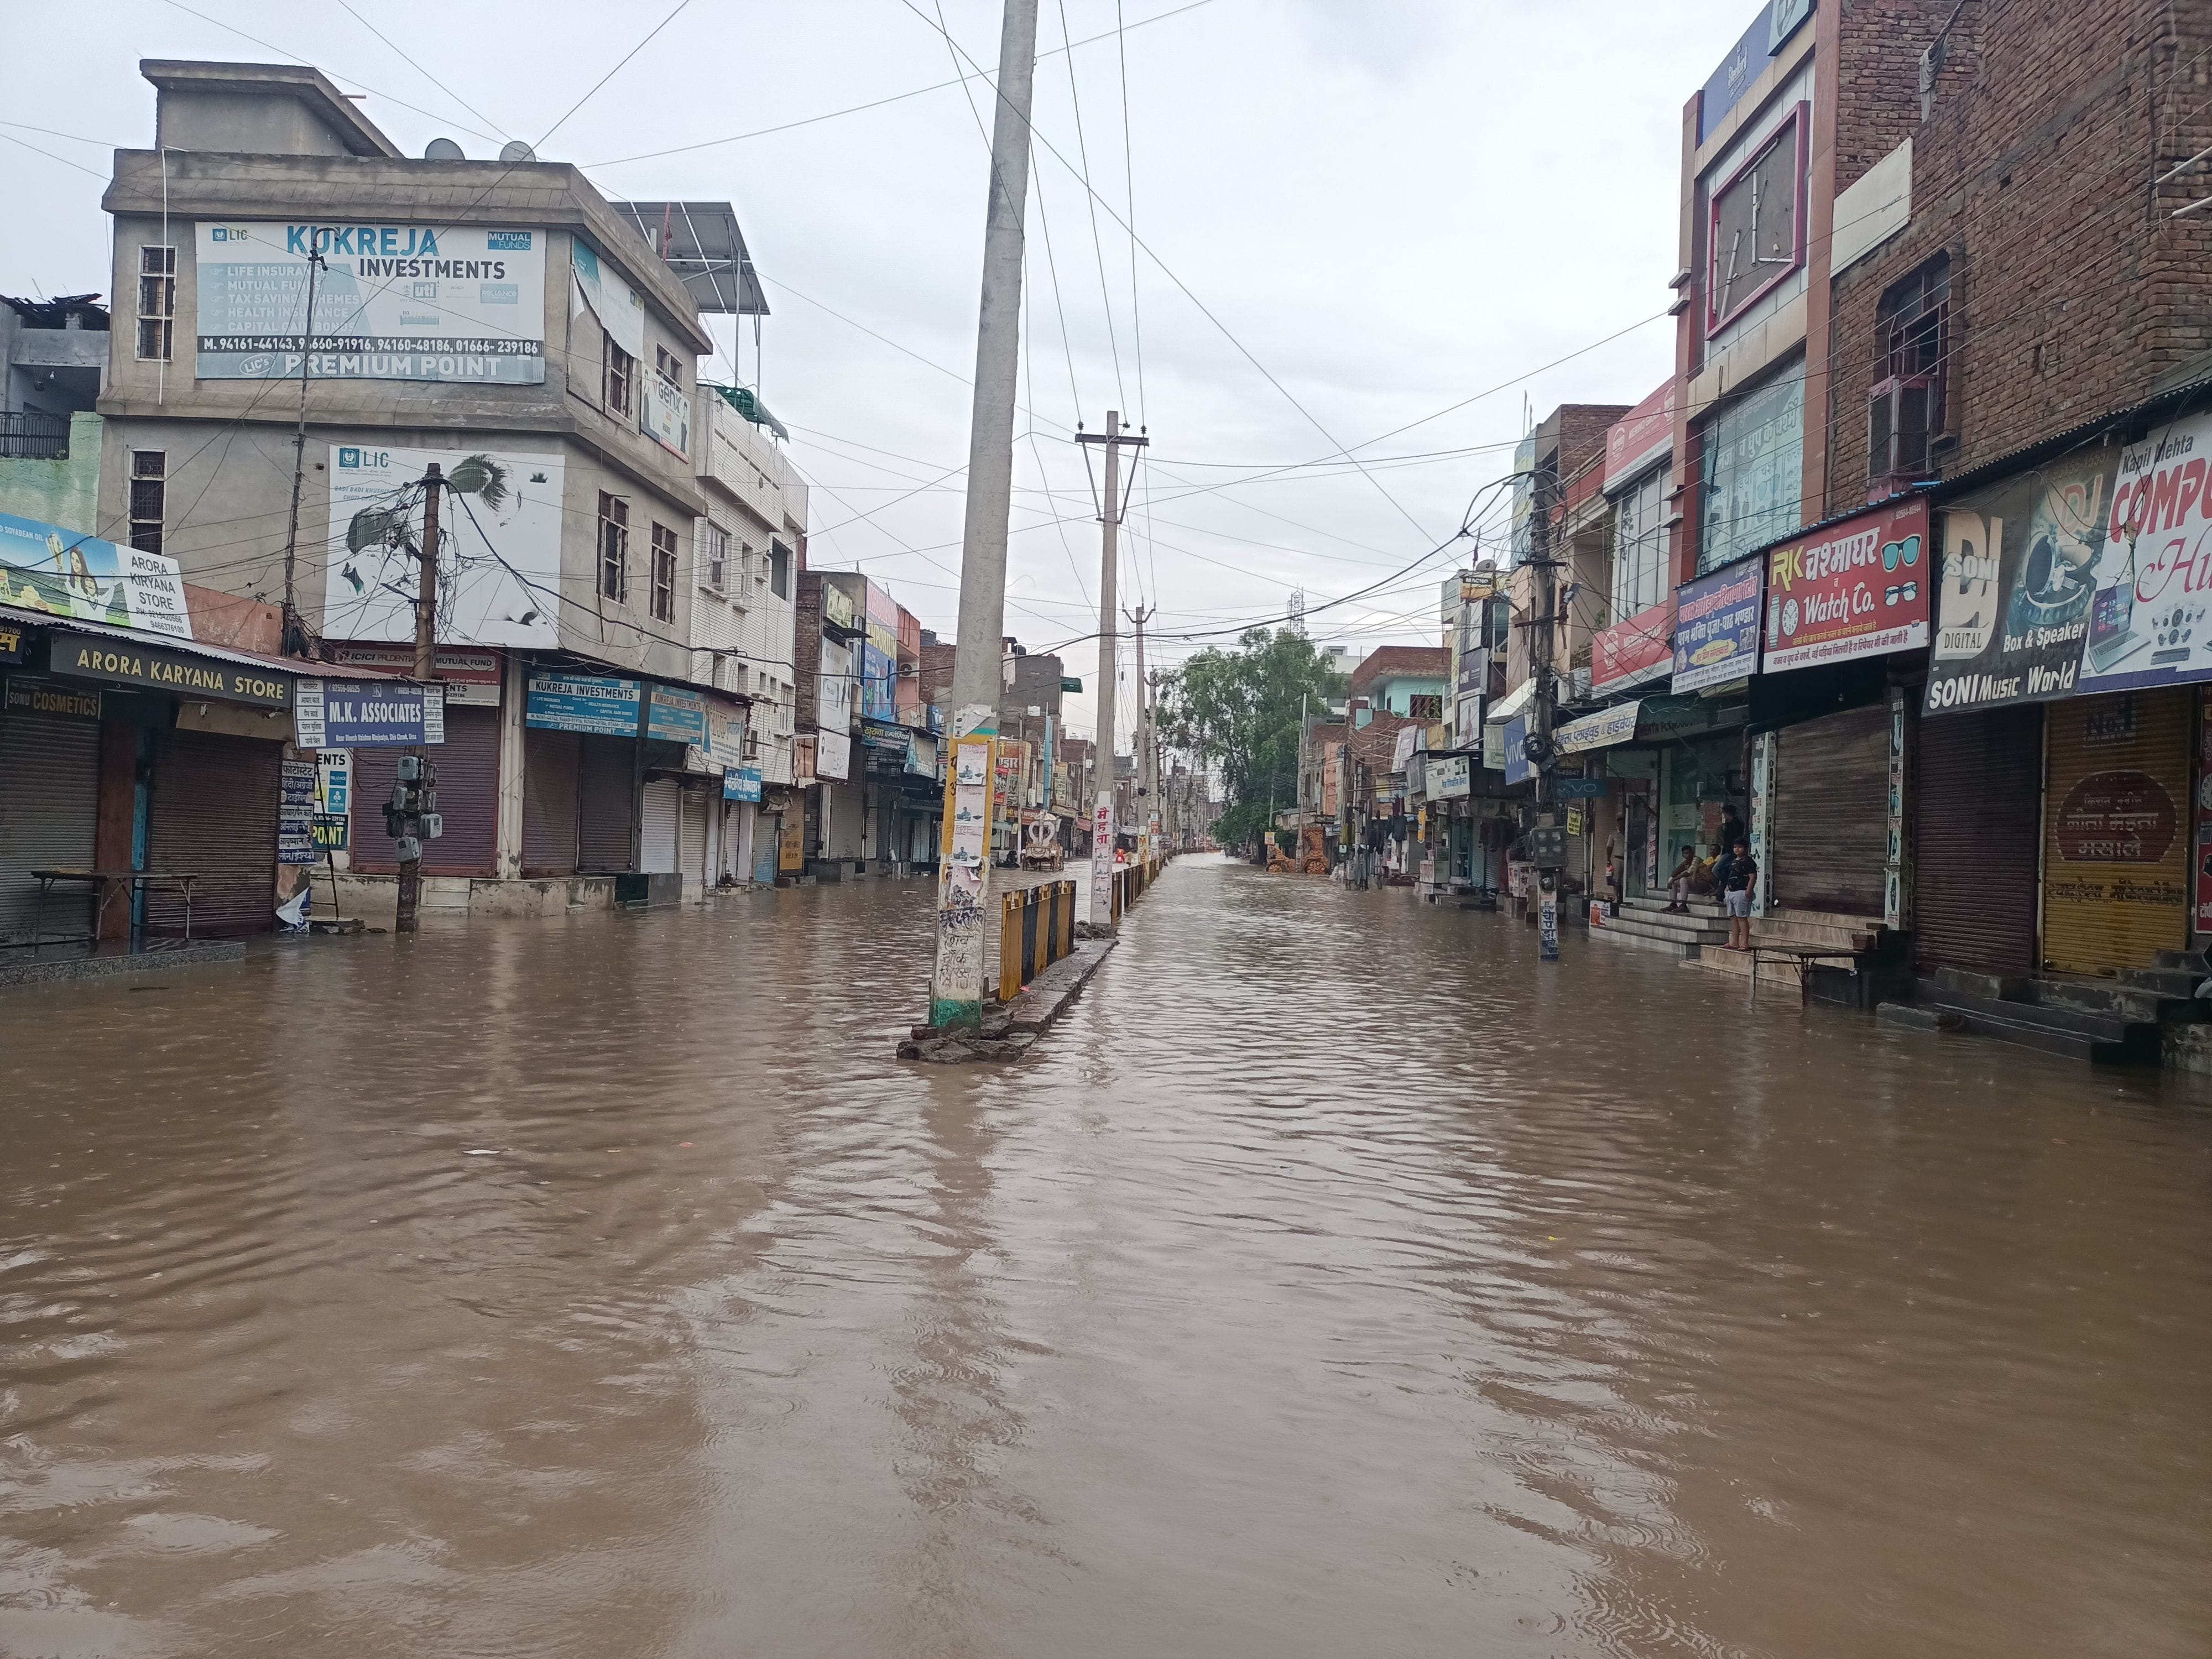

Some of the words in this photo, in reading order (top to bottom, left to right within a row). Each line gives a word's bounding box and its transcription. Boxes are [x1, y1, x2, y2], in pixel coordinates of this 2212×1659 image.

[229, 230, 248, 241] LIC
[288, 226, 440, 257] KUKREJA
[489, 233, 530, 242] MUTUAL
[228, 267, 254, 276] LIFE
[258, 267, 323, 276] INSURANC
[360, 259, 505, 279] INVESTMENTS
[228, 281, 278, 290] MUTUAL
[228, 294, 252, 304] TAX
[254, 294, 301, 304] SAVING
[303, 294, 359, 304] SHEMES
[228, 307, 274, 317] HEALTH
[279, 308, 349, 317] INSUANCE
[228, 322, 278, 332] CAPITAL
[204, 338, 217, 349] M.
[298, 338, 375, 352] 9660-91916,
[285, 354, 411, 375] PREMIUM
[421, 356, 502, 377] POINT
[363, 451, 389, 468] LIC
[2122, 446, 2152, 475] Kapil
[2154, 435, 2194, 464] Mehta
[4, 526, 33, 539] SOYABEAN
[34, 533, 44, 541] OIL
[132, 555, 168, 575] ARORA
[1942, 553, 2000, 581] SONI
[130, 572, 176, 594] KIRYANA
[139, 592, 174, 611] STORE
[1803, 588, 1849, 625] Watch
[1852, 581, 1875, 615] Co.
[1944, 632, 1982, 649] DIGITAL
[2003, 634, 2023, 653] Box
[2025, 629, 2034, 649] &
[2036, 621, 2085, 650] Speaker
[378, 654, 416, 662] PRUDENTIA
[436, 657, 467, 665] MUTUAL
[470, 658, 492, 666] FUND
[77, 649, 142, 676] ARORA
[150, 661, 223, 690] KARYANA
[234, 676, 284, 700] STORE
[535, 681, 572, 695] KUKREJA
[576, 685, 633, 700] INVESTMENTS
[1929, 674, 1979, 709] SONI
[2027, 660, 2077, 695] World
[655, 693, 674, 706] KUKREJA
[675, 697, 701, 711] INVESTMENTS
[329, 701, 357, 723] M.K.
[361, 702, 421, 723] ASSOCIATES
[559, 723, 593, 732] PREMIUM
[594, 726, 616, 734] POINT
[864, 726, 884, 738] खुराना
[283, 763, 314, 776] फोटोस्टेट
